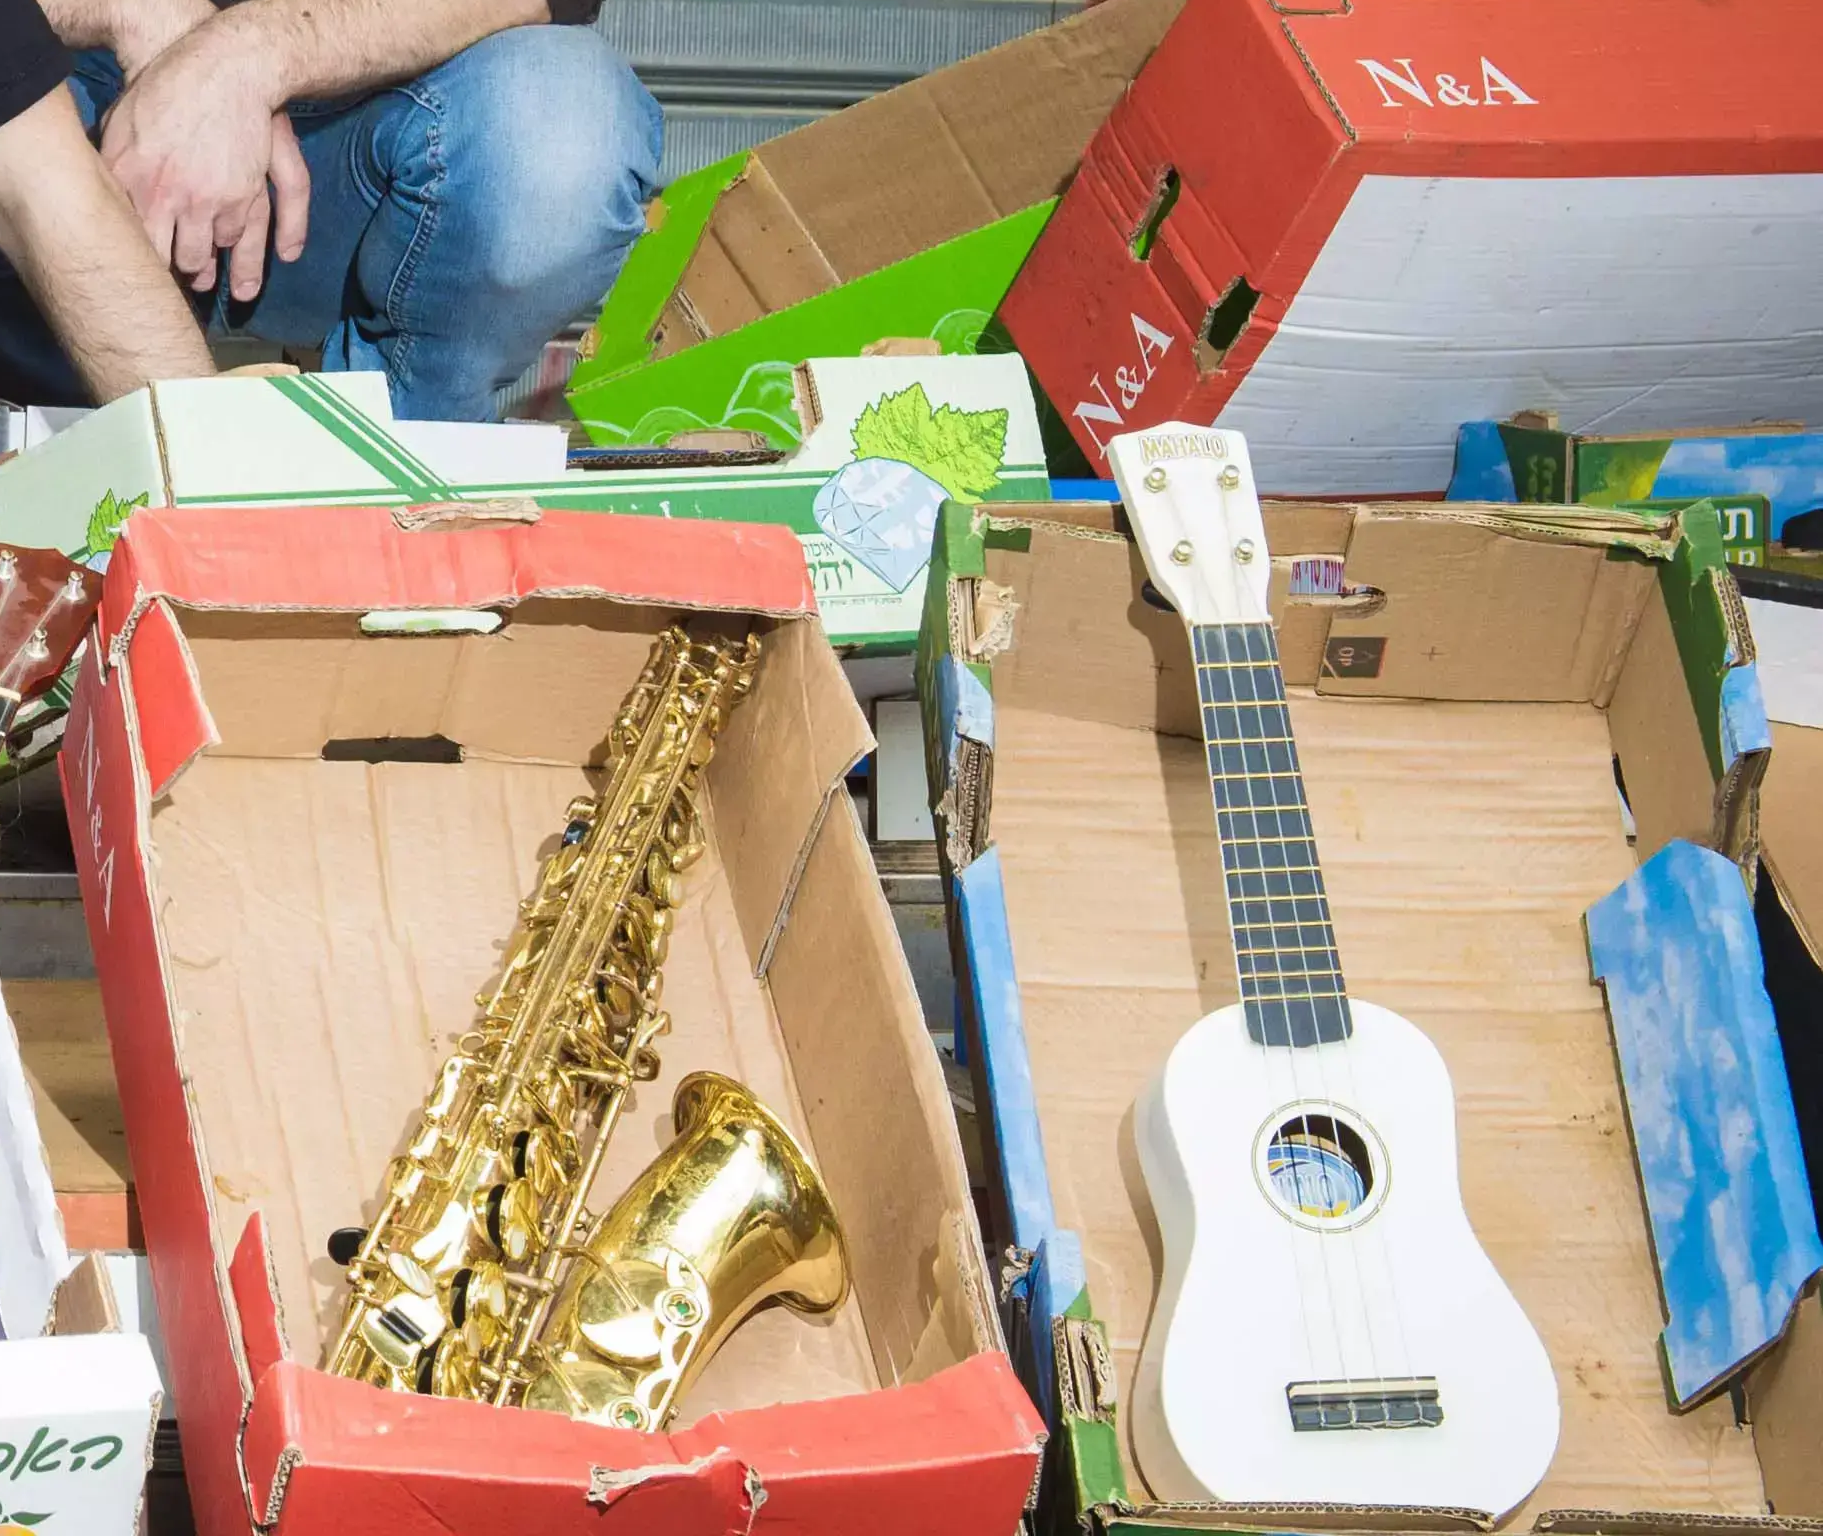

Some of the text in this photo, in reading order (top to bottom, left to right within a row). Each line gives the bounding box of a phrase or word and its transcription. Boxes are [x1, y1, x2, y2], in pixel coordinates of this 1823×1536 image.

[1357, 56, 1539, 107] N&A
[1073, 312, 1175, 459] N&A
[1138, 434, 1228, 465] MAHALO
[79, 706, 115, 932] N&A
